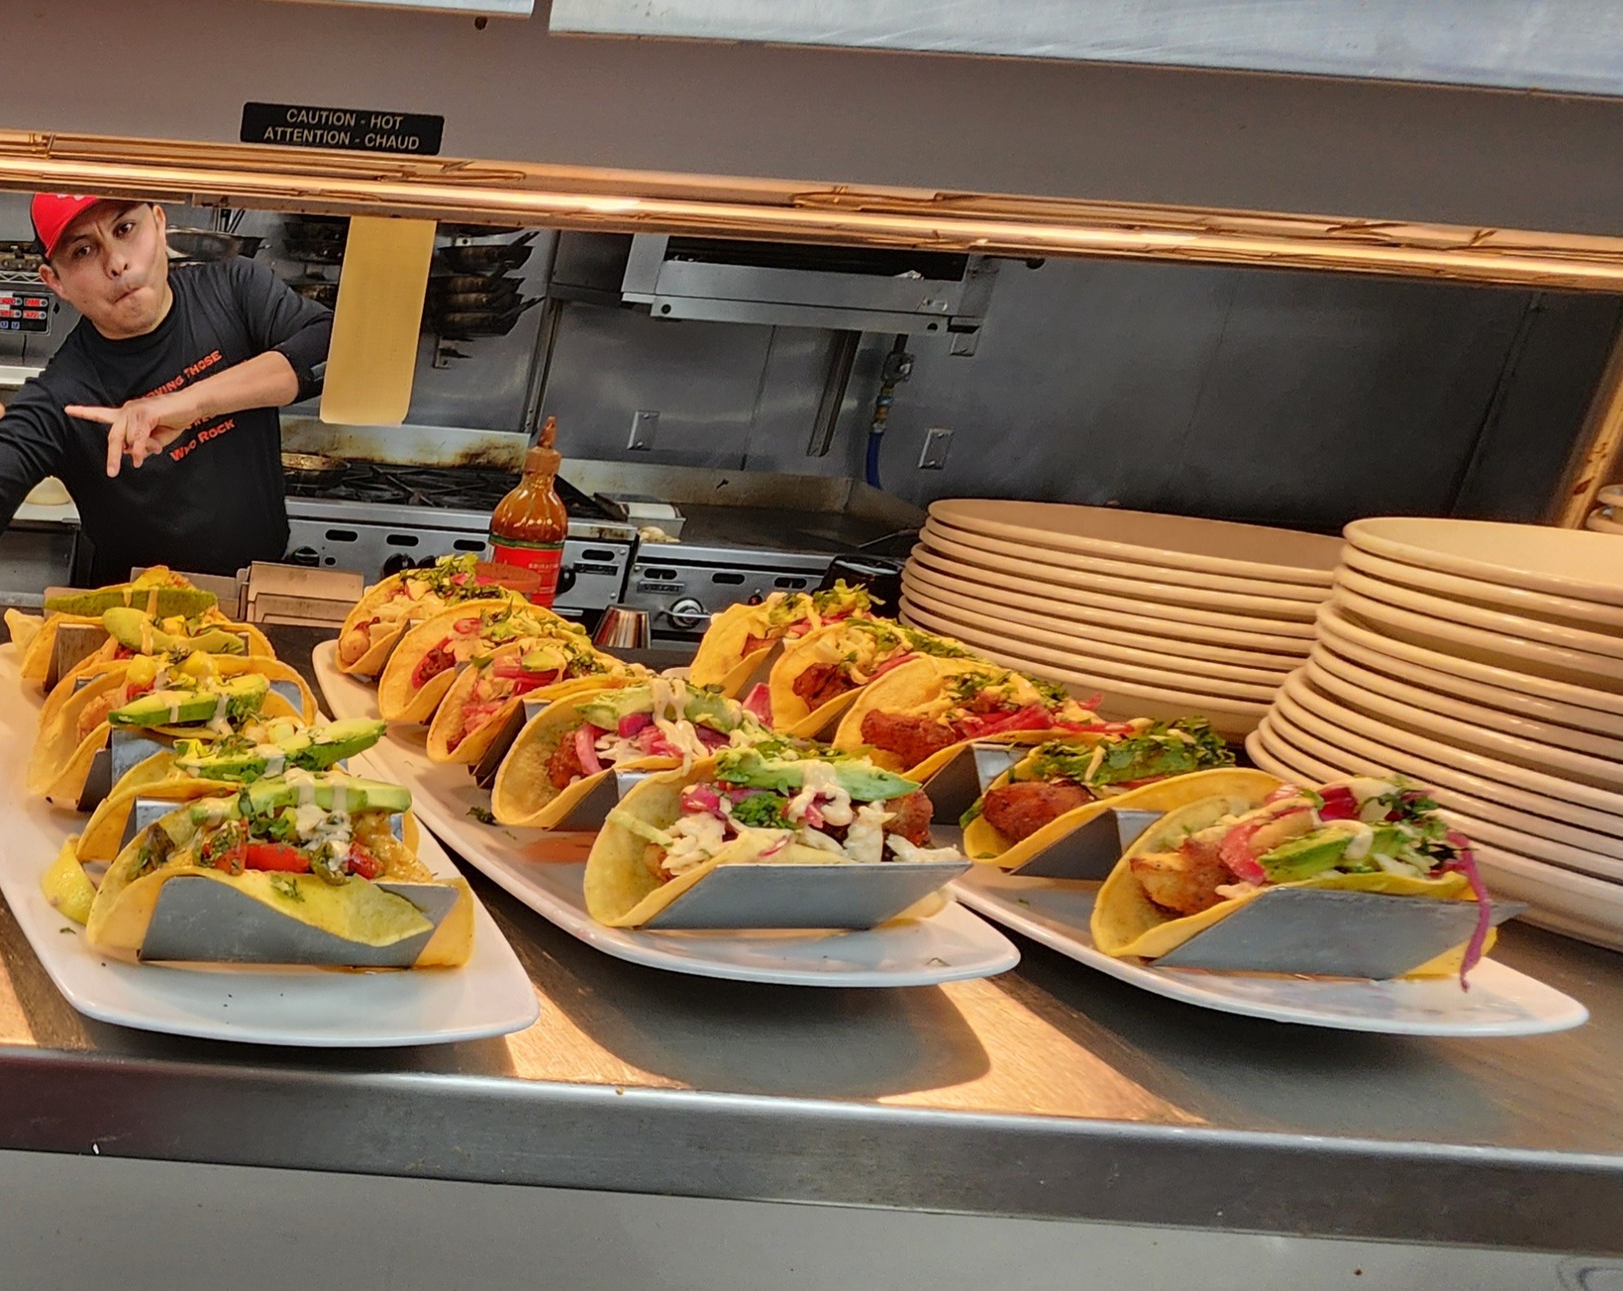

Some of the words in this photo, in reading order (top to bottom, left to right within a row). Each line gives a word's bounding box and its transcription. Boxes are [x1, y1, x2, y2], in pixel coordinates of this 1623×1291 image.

[287, 109, 356, 127] CAUTION
[370, 114, 403, 130] HOT
[264, 127, 350, 145] ATTENTION
[364, 133, 420, 150] CHAUD
[183, 350, 222, 377] THOSE
[197, 419, 235, 443] ROCK
